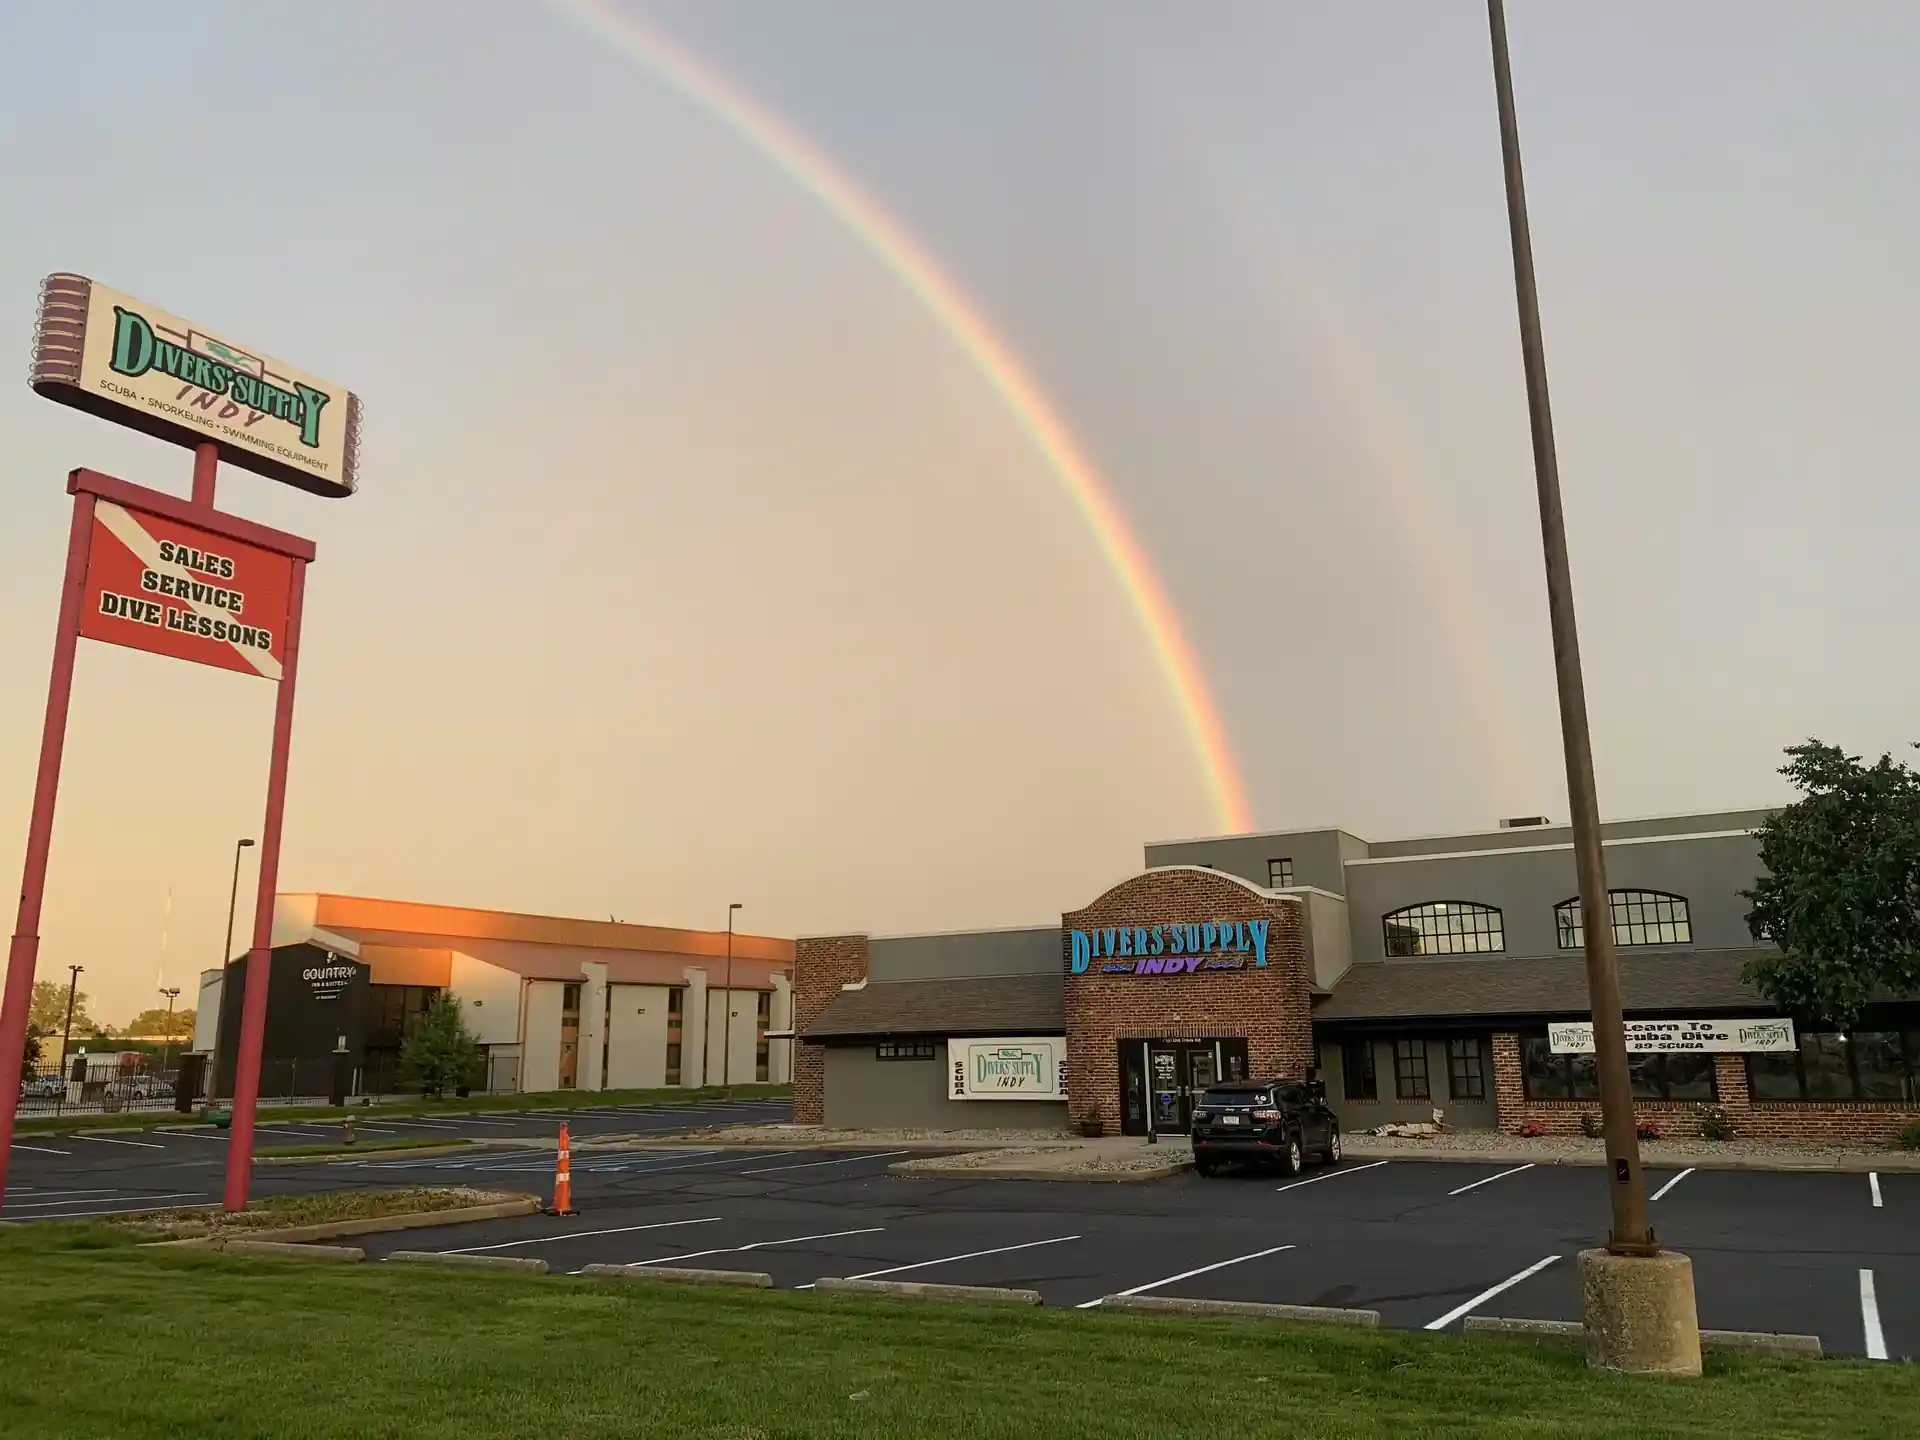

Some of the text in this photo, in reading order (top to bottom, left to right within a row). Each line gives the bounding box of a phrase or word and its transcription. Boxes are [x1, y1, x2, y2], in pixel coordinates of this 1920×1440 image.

[175, 385, 265, 427] INDY
[231, 374, 330, 448] SUPPLY
[100, 379, 329, 471] SCUBA SNORKELING SWIMMING EQUIPMENT
[159, 542, 234, 578] SALES
[142, 569, 243, 613] SERVICE
[101, 592, 271, 650] DIVE LESSONS
[1171, 919, 1270, 968] SUPPLY
[303, 967, 354, 980] COUNTRY
[1134, 957, 1205, 974] INDY
[1623, 1031, 1729, 1041] cuba Dive
[1687, 1022, 1713, 1031] To
[954, 1061, 964, 1095] SCUBA
[996, 1076, 1026, 1088] INDY
